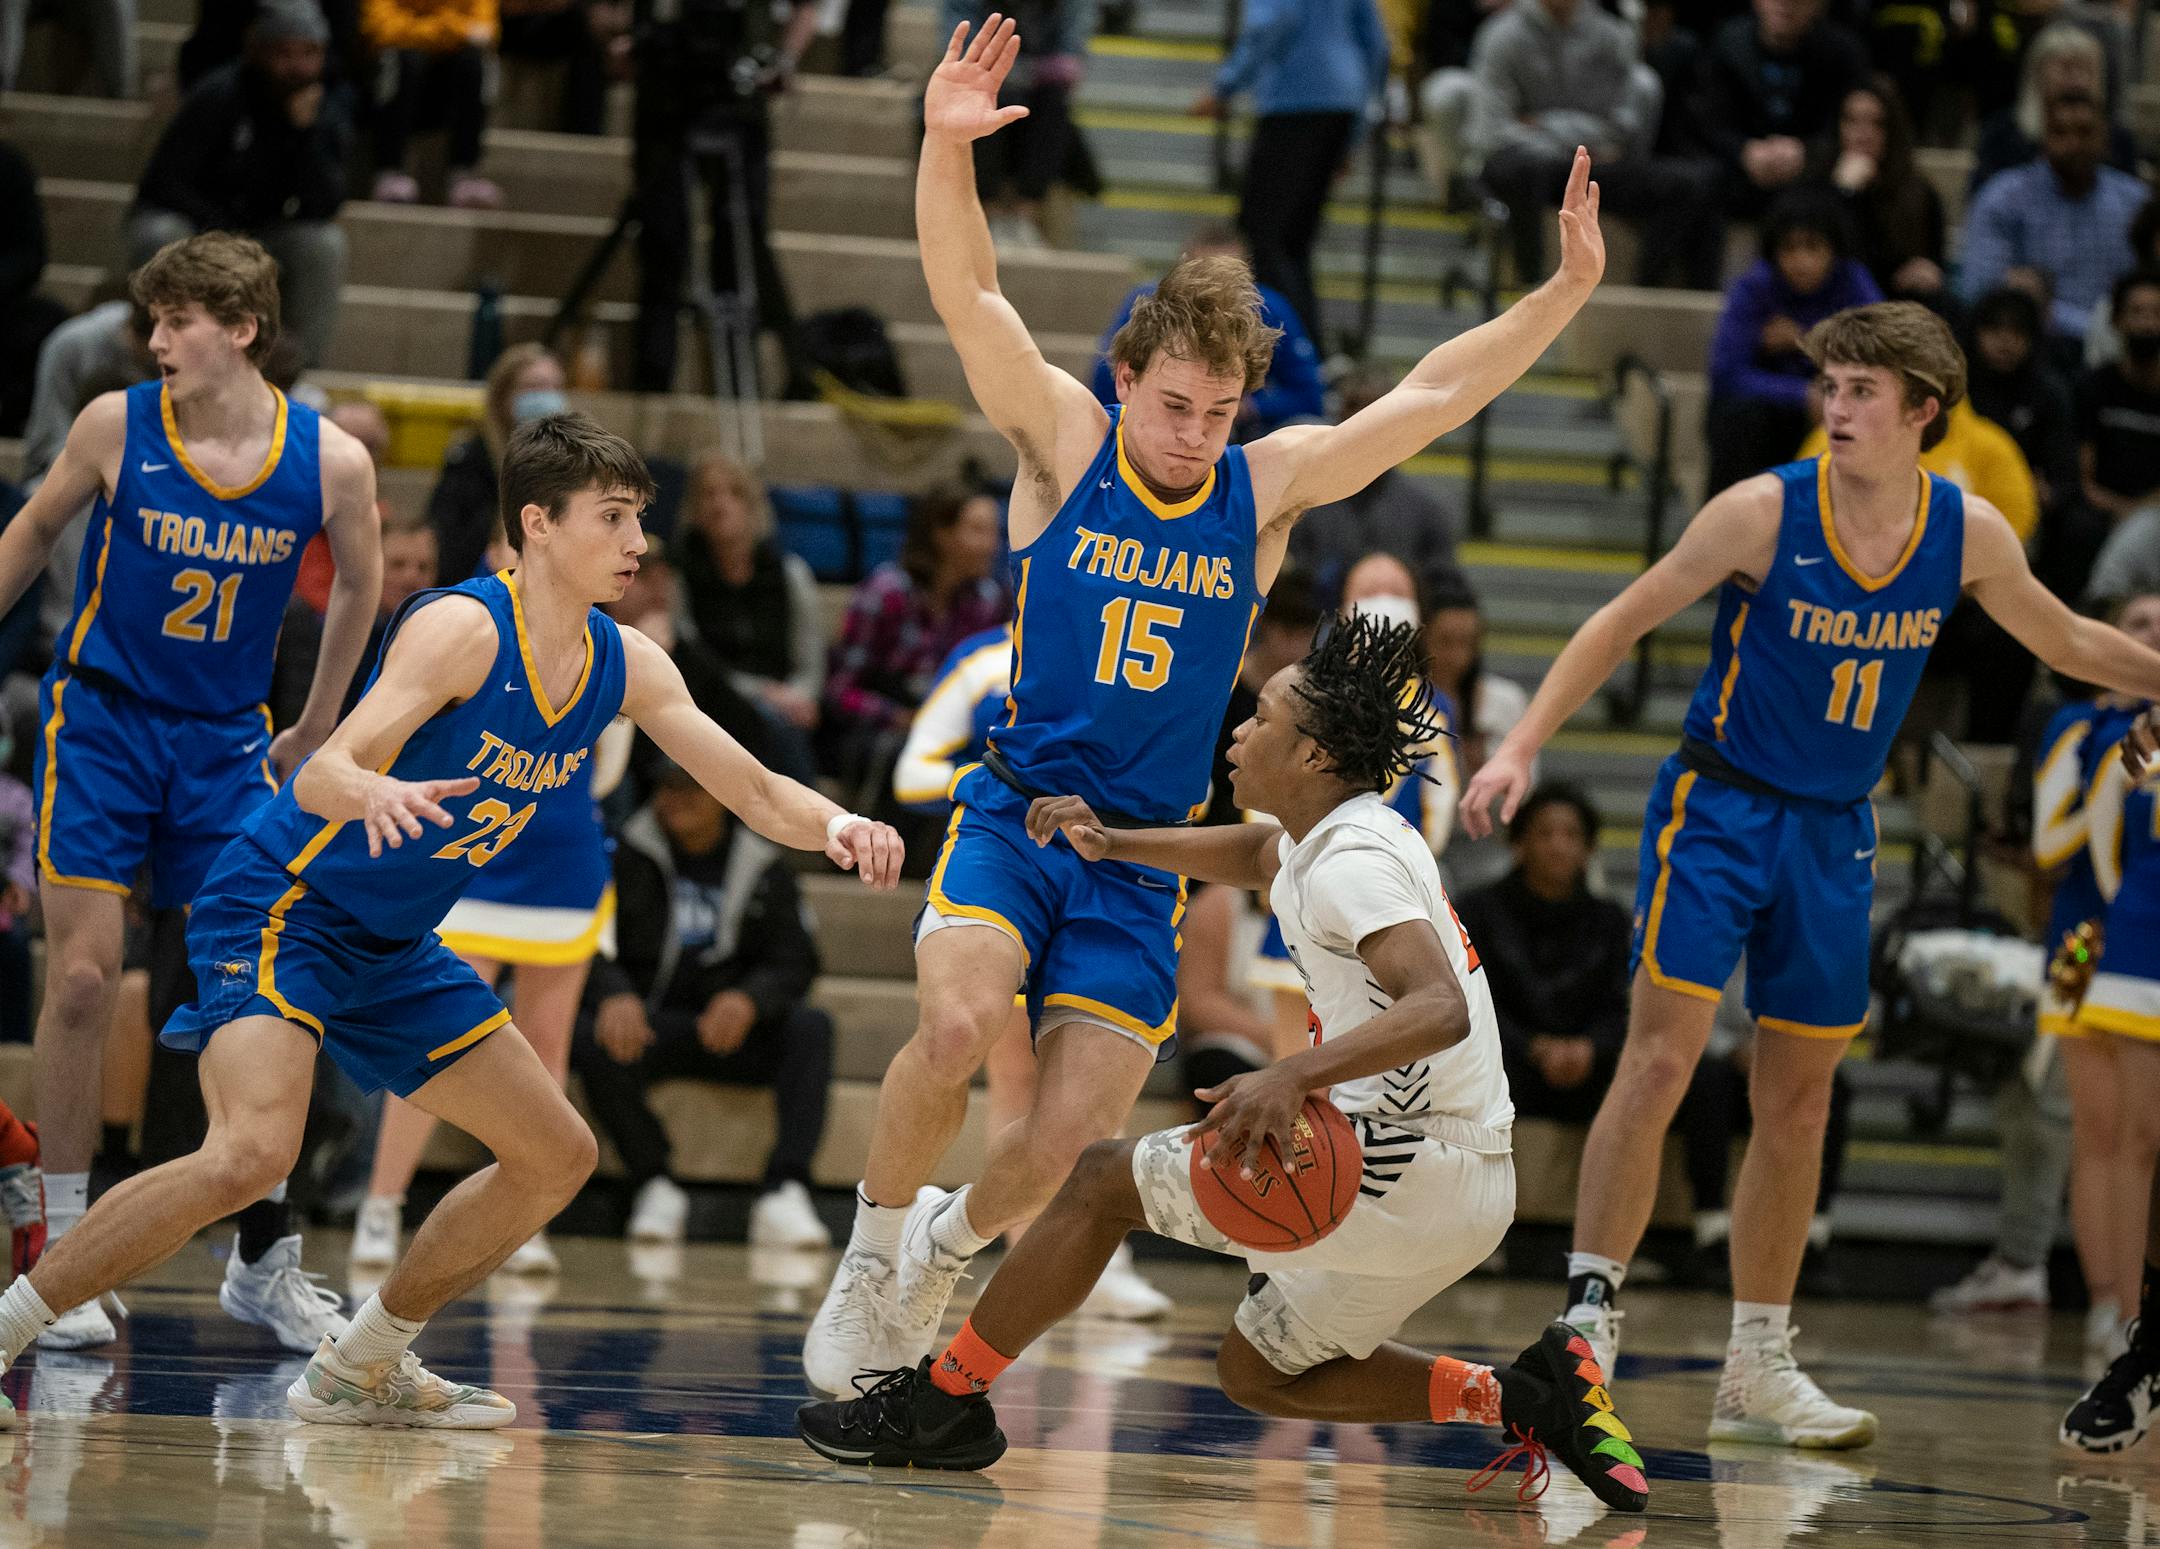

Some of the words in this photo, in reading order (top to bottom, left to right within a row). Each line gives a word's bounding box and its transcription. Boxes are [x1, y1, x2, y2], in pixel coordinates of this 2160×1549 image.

[138, 507, 297, 565] TROJANS
[1067, 525, 1234, 599] TROJANS
[161, 567, 244, 643] 21
[1788, 598, 1942, 650] TROJANS
[1094, 596, 1185, 692] 15
[1824, 658, 1884, 732] 11
[466, 730, 588, 793] TROJANS
[430, 797, 537, 868] 23
